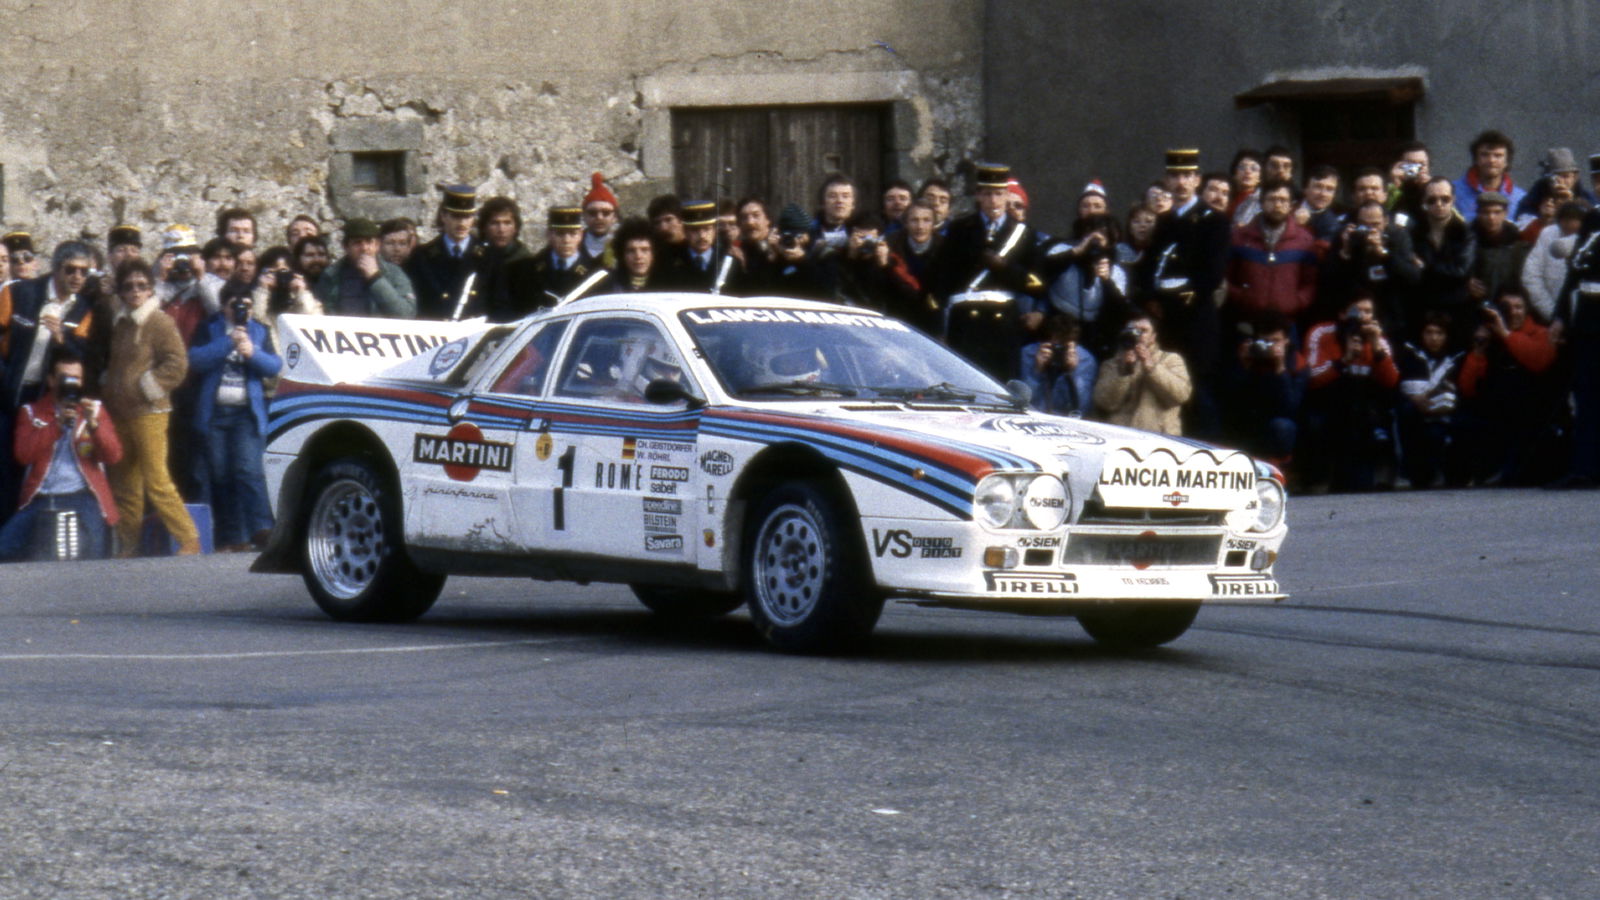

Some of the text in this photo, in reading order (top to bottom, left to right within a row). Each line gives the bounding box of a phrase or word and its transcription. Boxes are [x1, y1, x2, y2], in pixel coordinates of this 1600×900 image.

[687, 308, 799, 324] LANCIA
[419, 438, 508, 466] MARTINI
[596, 462, 642, 490] ROME
[652, 467, 687, 479] FERODO
[1099, 467, 1253, 489] LANCIA MARTINI
[554, 445, 576, 531] 1
[1042, 498, 1064, 508] SIEM
[872, 528, 912, 558] VS
[921, 547, 962, 558] FIAT
[1033, 537, 1061, 547] SIEM
[983, 571, 1079, 594] PIRELLI
[1207, 573, 1279, 595] PIRELLI
